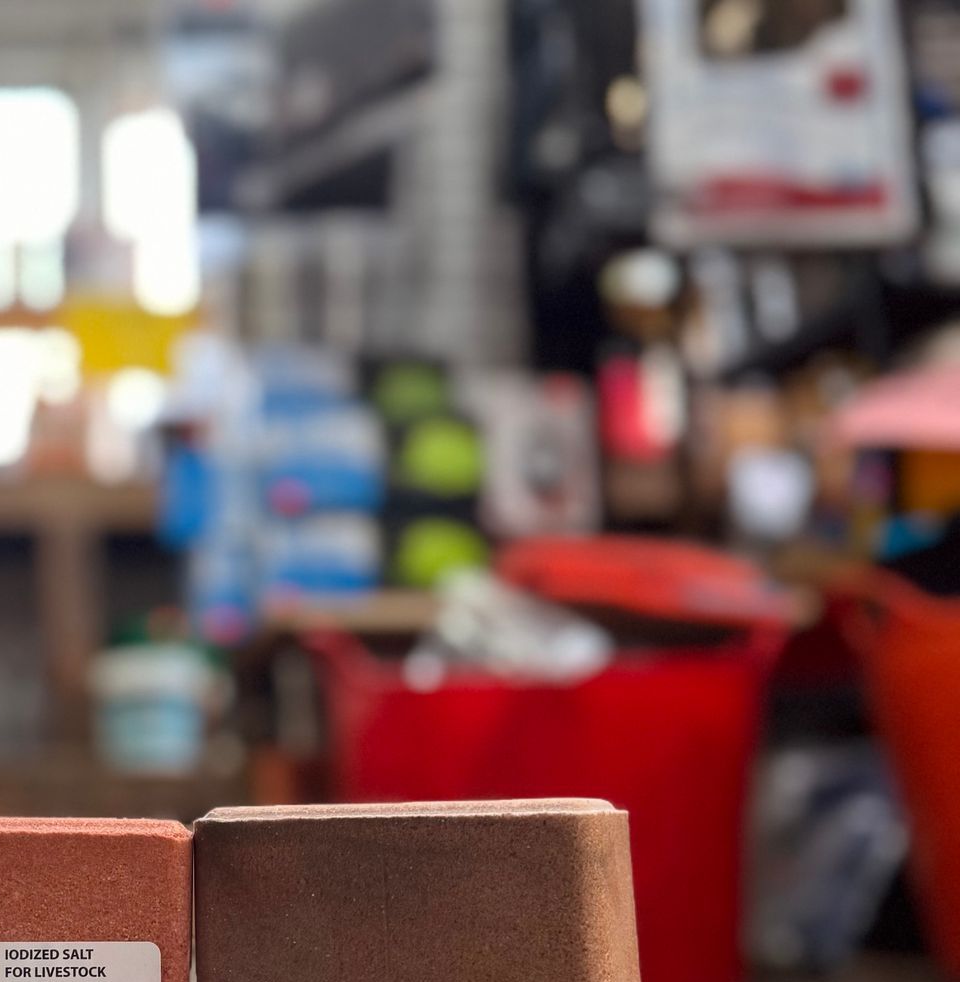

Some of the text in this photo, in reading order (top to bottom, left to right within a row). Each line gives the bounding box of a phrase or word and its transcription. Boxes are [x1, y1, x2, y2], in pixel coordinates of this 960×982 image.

[5, 948, 93, 960] IODIZED SALT
[5, 966, 106, 977] FOR LIVESTOCK
